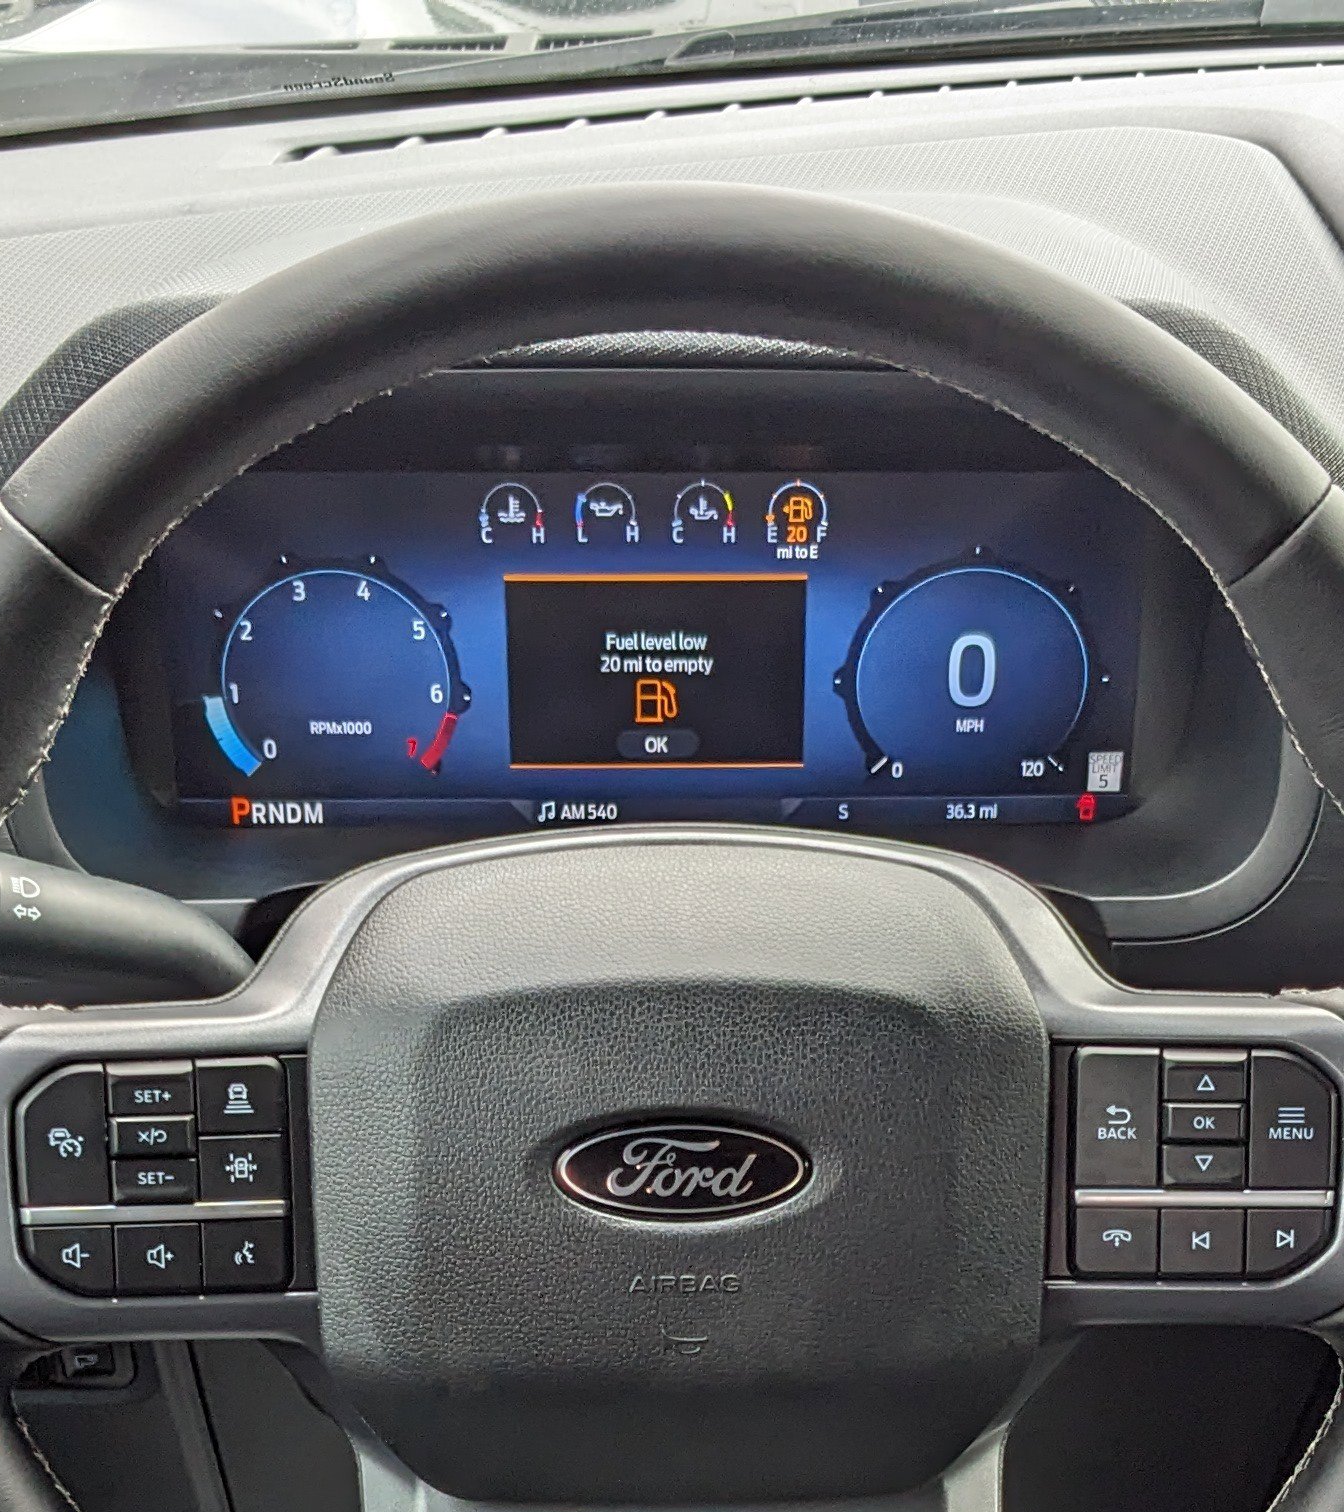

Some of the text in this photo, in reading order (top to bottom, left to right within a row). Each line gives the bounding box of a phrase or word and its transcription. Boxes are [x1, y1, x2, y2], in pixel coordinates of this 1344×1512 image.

[481, 528, 493, 543] C
[533, 527, 545, 543] H
[577, 528, 587, 543] L
[626, 527, 639, 542] H
[672, 527, 683, 543] C
[723, 527, 735, 543] H
[768, 527, 777, 542] E
[786, 527, 807, 543] 20
[817, 527, 827, 542] F
[795, 547, 808, 559] to
[810, 546, 818, 559] E
[293, 582, 306, 601] 3
[356, 582, 371, 601] 4
[240, 621, 253, 641] 2
[412, 621, 425, 640] 5
[606, 631, 707, 650] Fuel level low
[600, 656, 714, 676] 20 mi to empty
[947, 634, 996, 707] 0
[230, 684, 239, 703] 1
[430, 684, 443, 703] 6
[310, 721, 372, 736] RPMx1000
[955, 719, 984, 733] MPH
[263, 740, 277, 760] 0
[406, 739, 417, 757] 7
[644, 736, 669, 753] OK
[891, 761, 903, 779] 0
[1021, 761, 1044, 777] 120
[1098, 774, 1108, 788] 5
[560, 804, 618, 820] AM 540
[839, 804, 849, 820] S
[946, 804, 975, 819] 36.3
[1193, 1116, 1216, 1130] OK
[1097, 1127, 1137, 1140] BACK
[1269, 1127, 1314, 1140] MENU
[607, 1137, 758, 1198] Ford
[628, 1273, 742, 1294] AIRBAG
